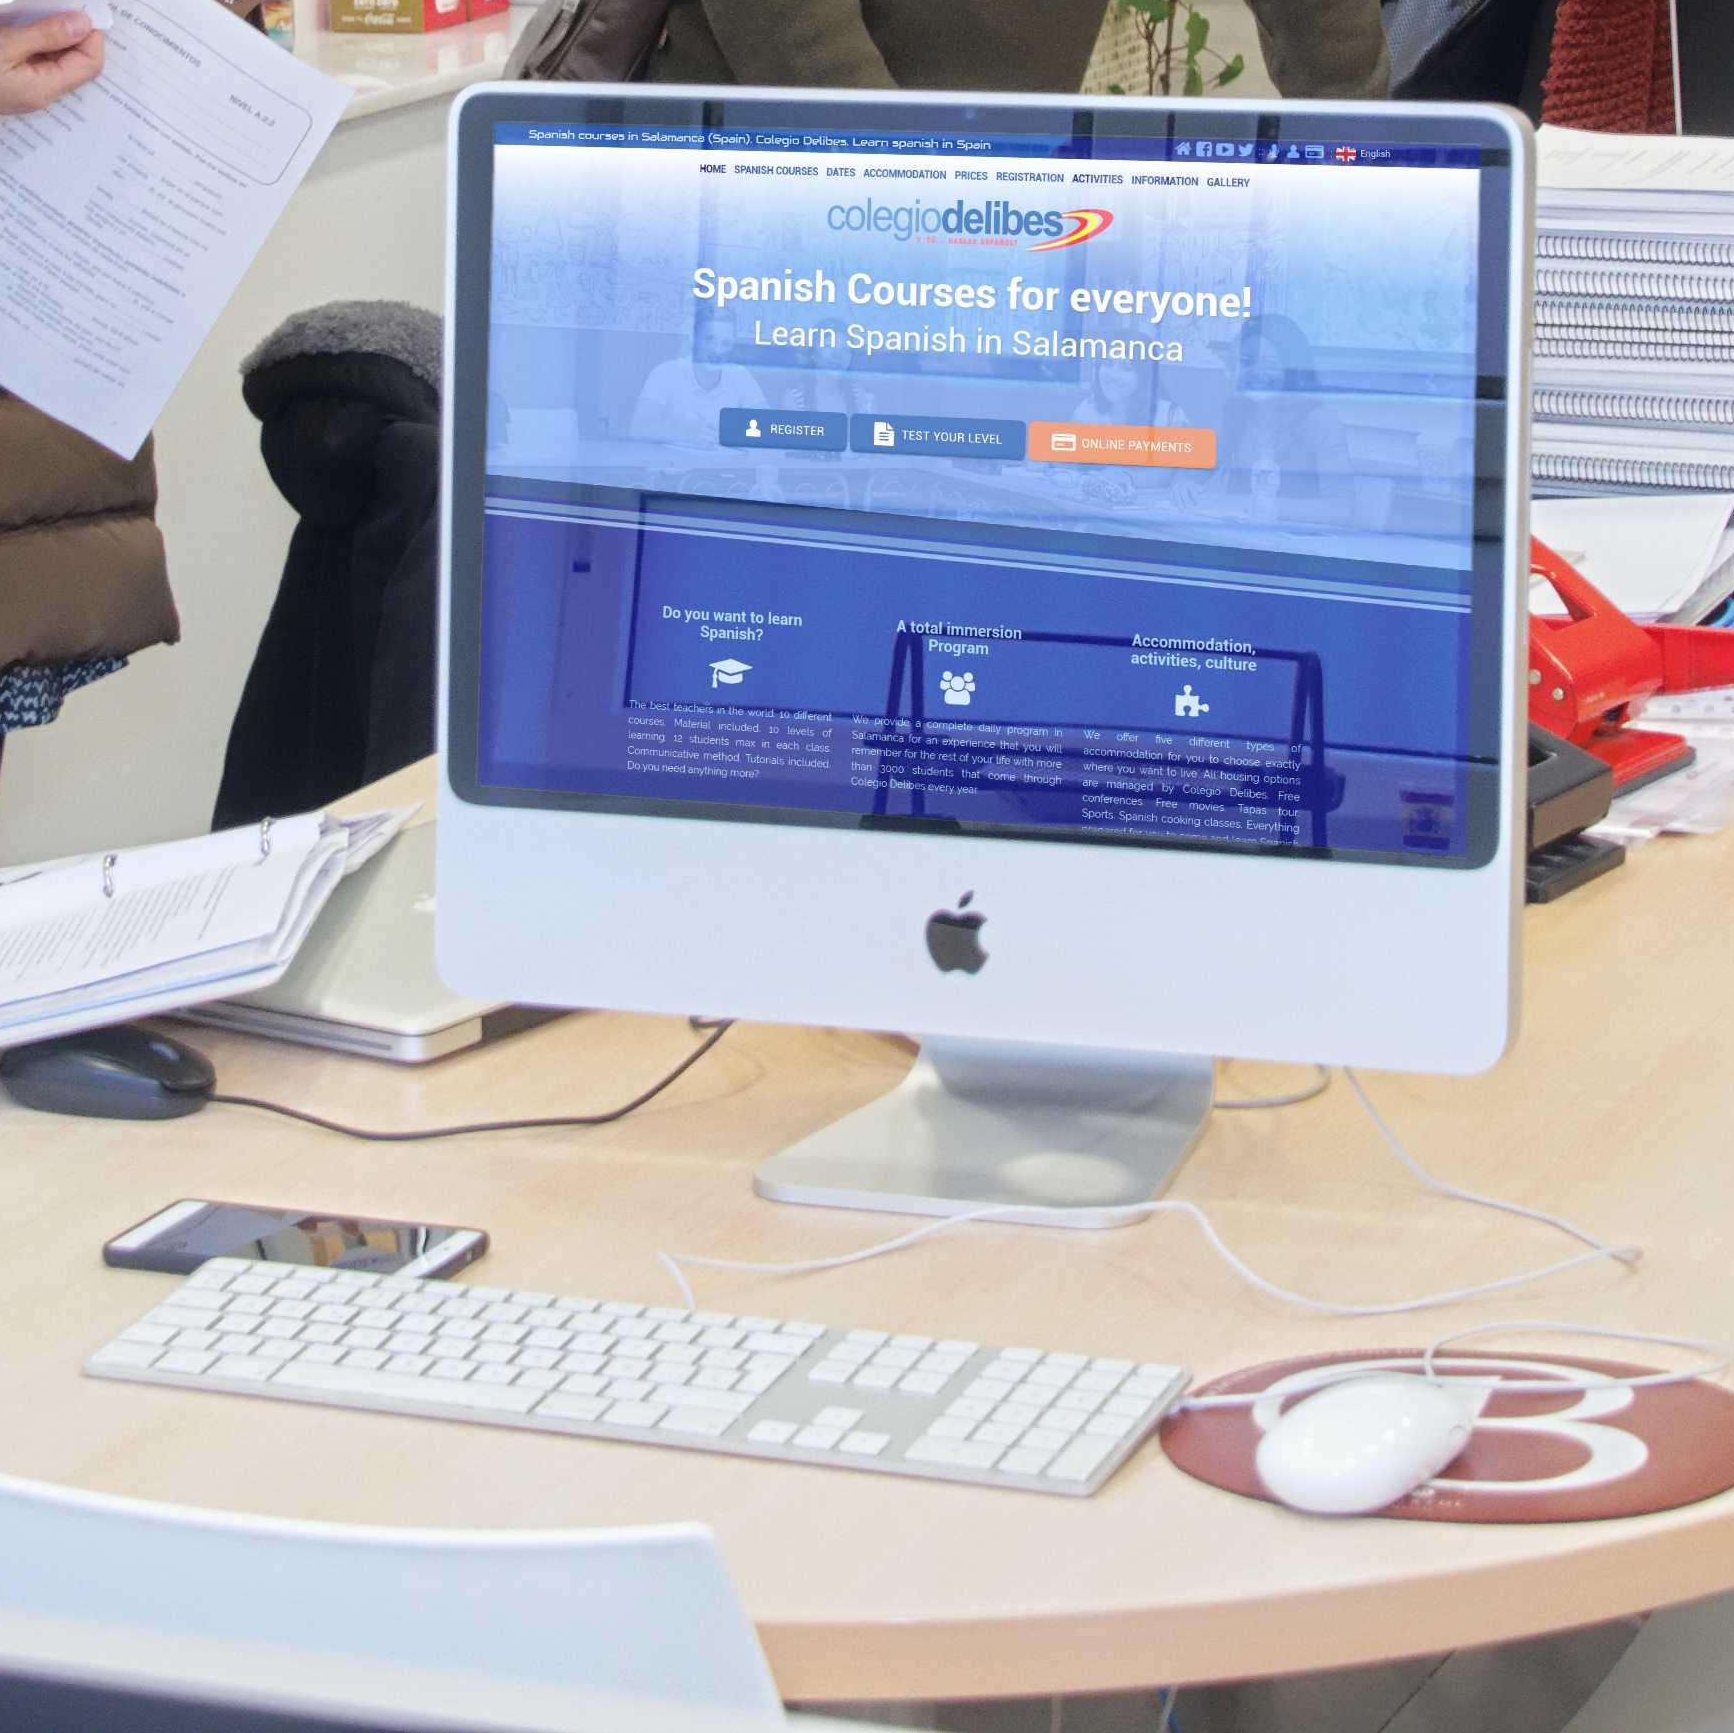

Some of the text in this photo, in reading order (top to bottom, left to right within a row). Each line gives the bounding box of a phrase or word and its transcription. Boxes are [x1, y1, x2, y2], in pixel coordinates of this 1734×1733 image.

[528, 129, 576, 141] Spanish
[578, 132, 625, 141] courses
[628, 131, 639, 141] in
[641, 132, 706, 143] Salamanca
[756, 134, 800, 148] Colegio
[852, 137, 889, 147] Learn
[892, 138, 939, 150] spanish
[942, 138, 954, 149] in
[956, 140, 992, 152] Spain
[1360, 149, 1392, 160] English
[699, 164, 1250, 188] HOME SPANISH COURSES DATES ACCOMMODATION PRICES REGISTRATION ACTIVITIES INFORMATION GALLERY
[692, 268, 1251, 324] Spanish Courses for everyone!
[755, 320, 1183, 362] Learn Spanish in Salamanca
[770, 424, 824, 436] REGISTER
[901, 430, 1003, 445] TEST YOUR LEVEL
[1082, 437, 1194, 453] ONLINE PAYMENTS
[662, 605, 802, 626] Do you want to learn
[700, 625, 764, 642] Spanish?
[896, 620, 1022, 640] A total immersion
[928, 638, 989, 657] Program
[1132, 634, 1256, 656] Accommodation,
[1130, 653, 1258, 672] activities, culture
